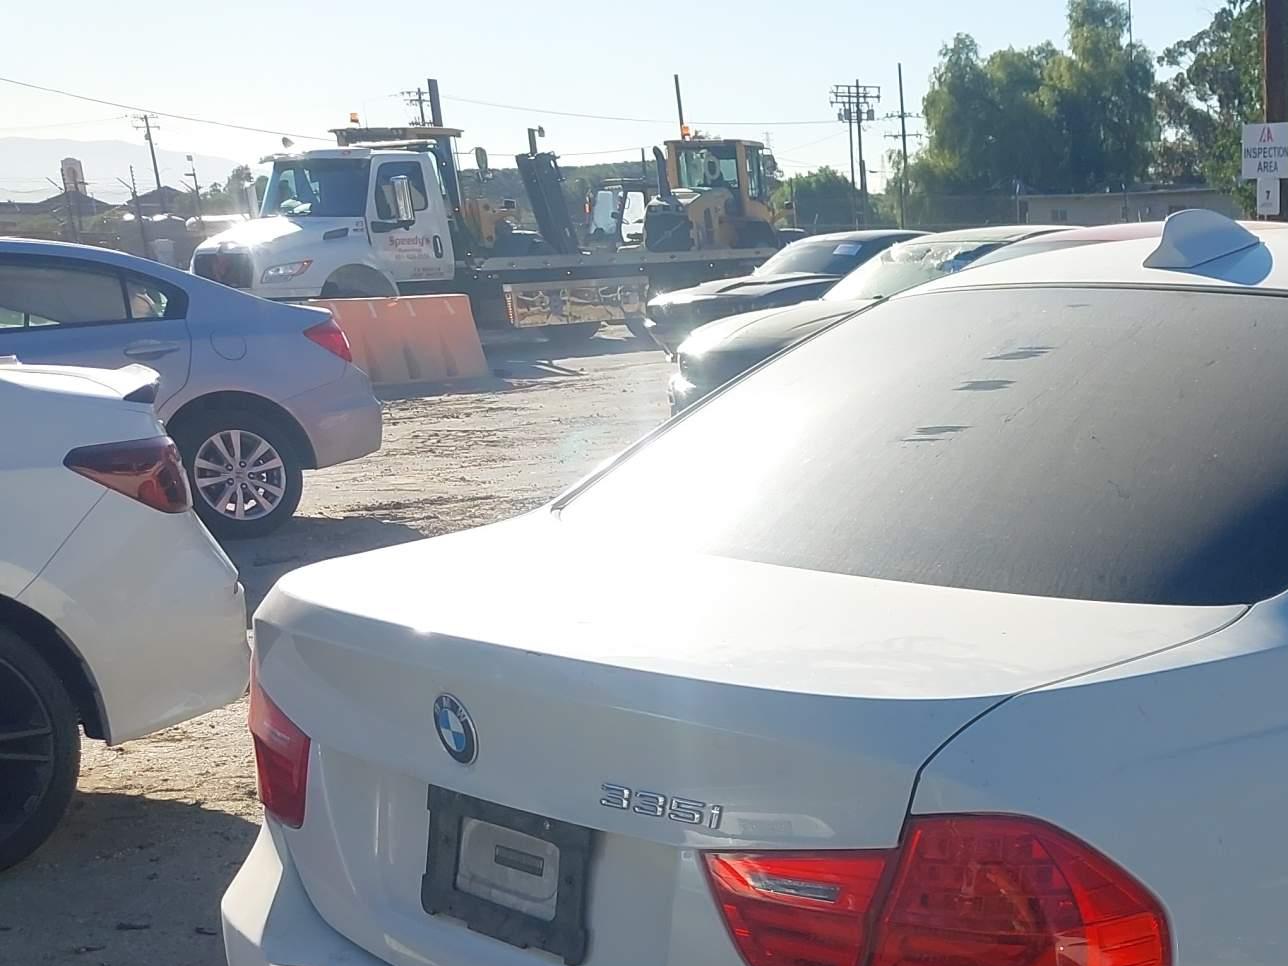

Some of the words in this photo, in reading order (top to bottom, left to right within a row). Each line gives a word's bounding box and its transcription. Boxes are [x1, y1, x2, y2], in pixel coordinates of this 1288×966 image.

[1243, 146, 1288, 159] INSPECTION
[1257, 160, 1278, 173] AREA
[1265, 190, 1271, 201] 7
[600, 783, 723, 829] 335i
